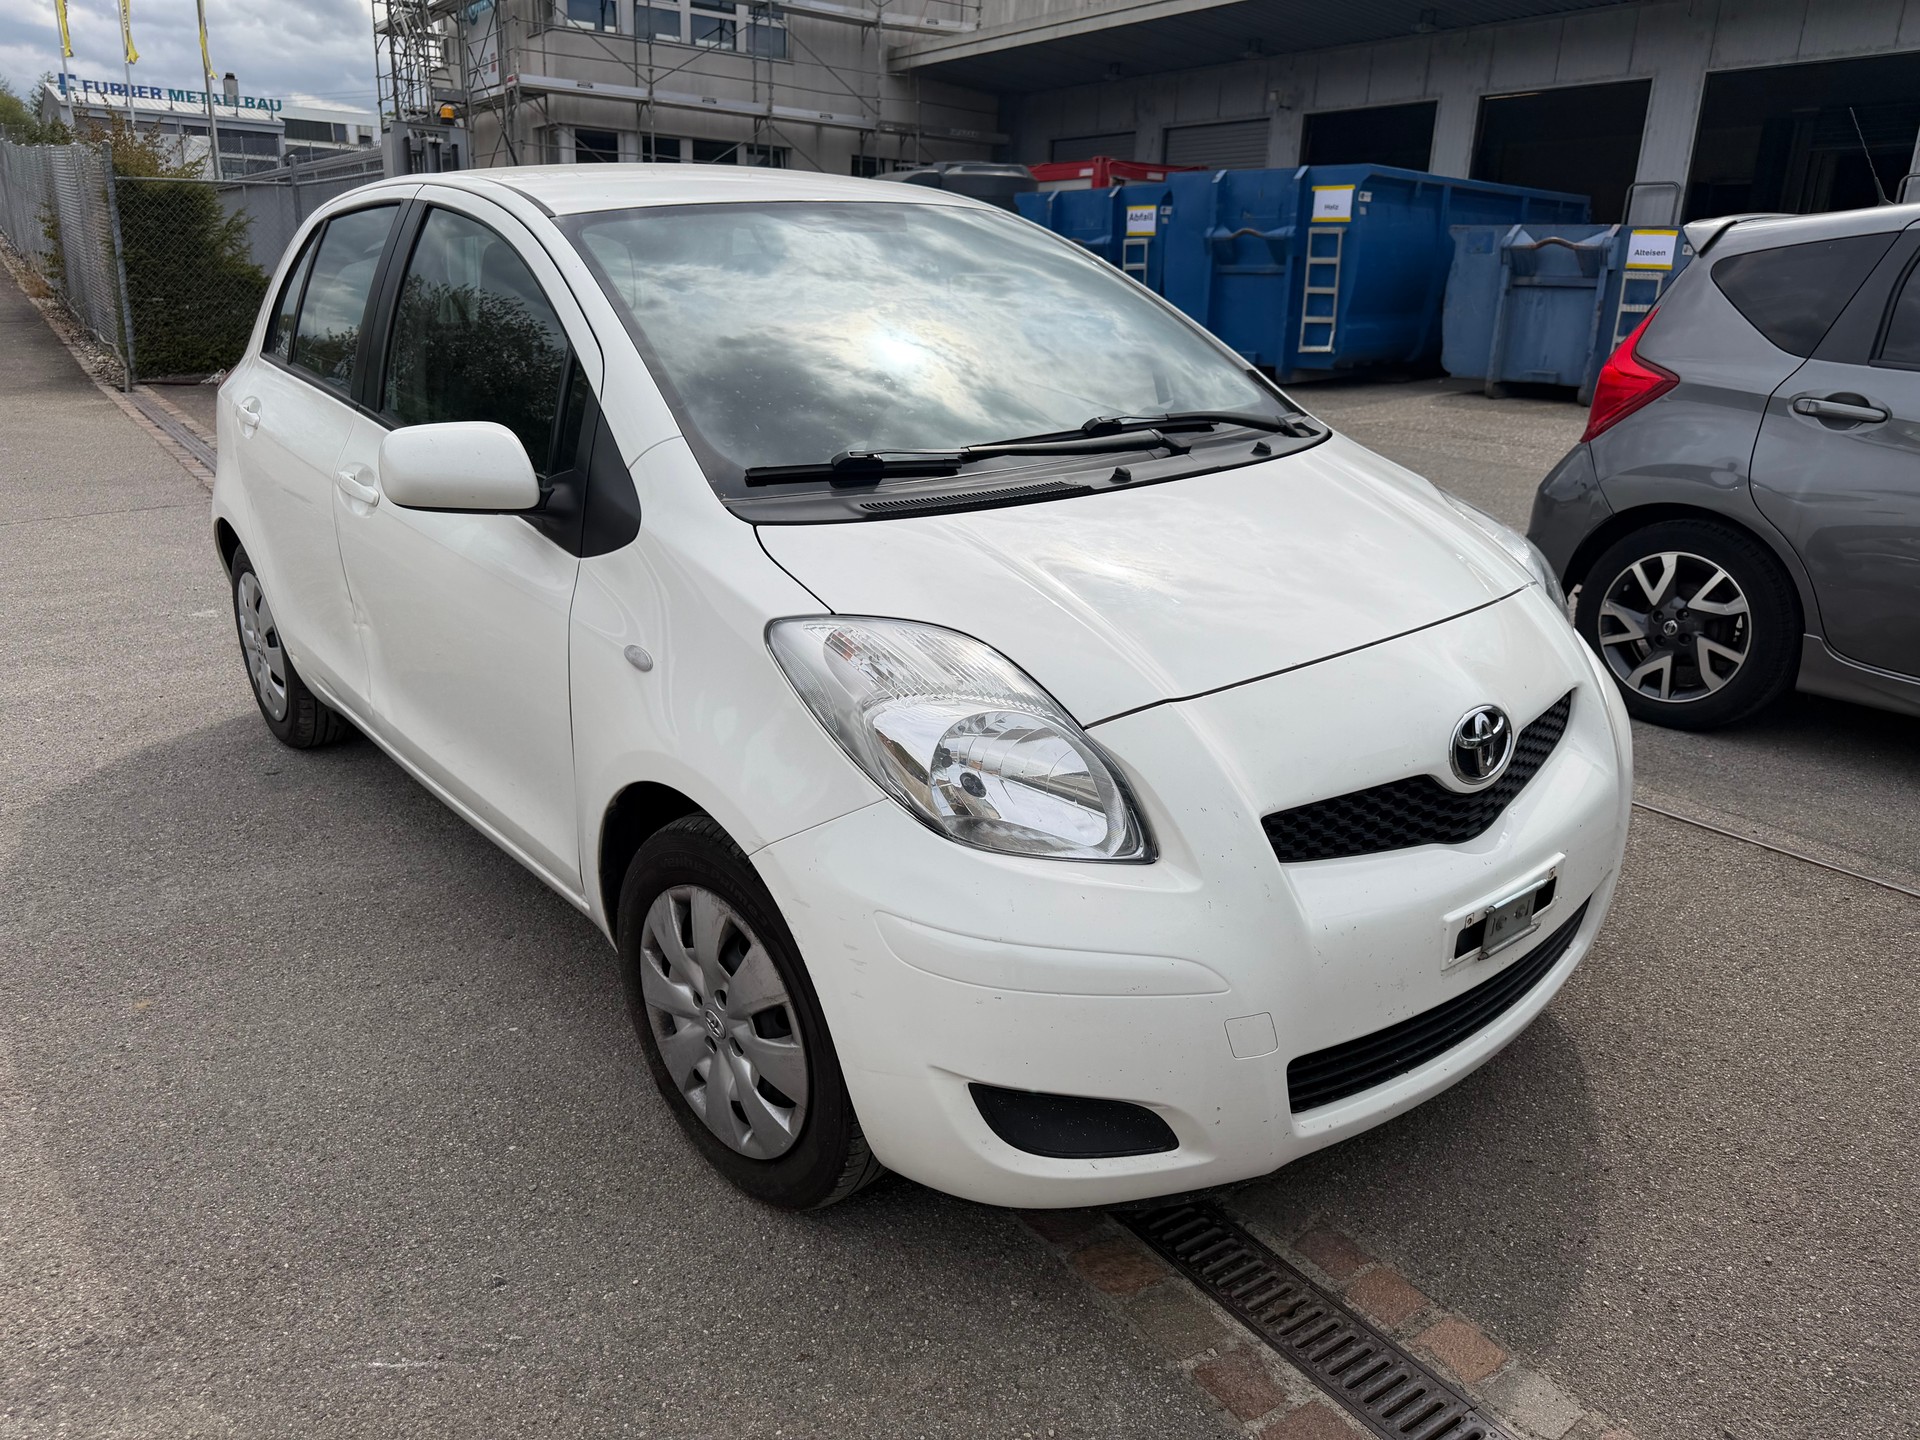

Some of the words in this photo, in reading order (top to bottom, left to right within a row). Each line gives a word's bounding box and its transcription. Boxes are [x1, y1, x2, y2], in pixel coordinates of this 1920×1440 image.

[83, 80, 162, 100] FURRER
[168, 88, 282, 112] METALLBAU
[1129, 211, 1154, 222] Abfall
[1634, 249, 1666, 257] Alteisen
